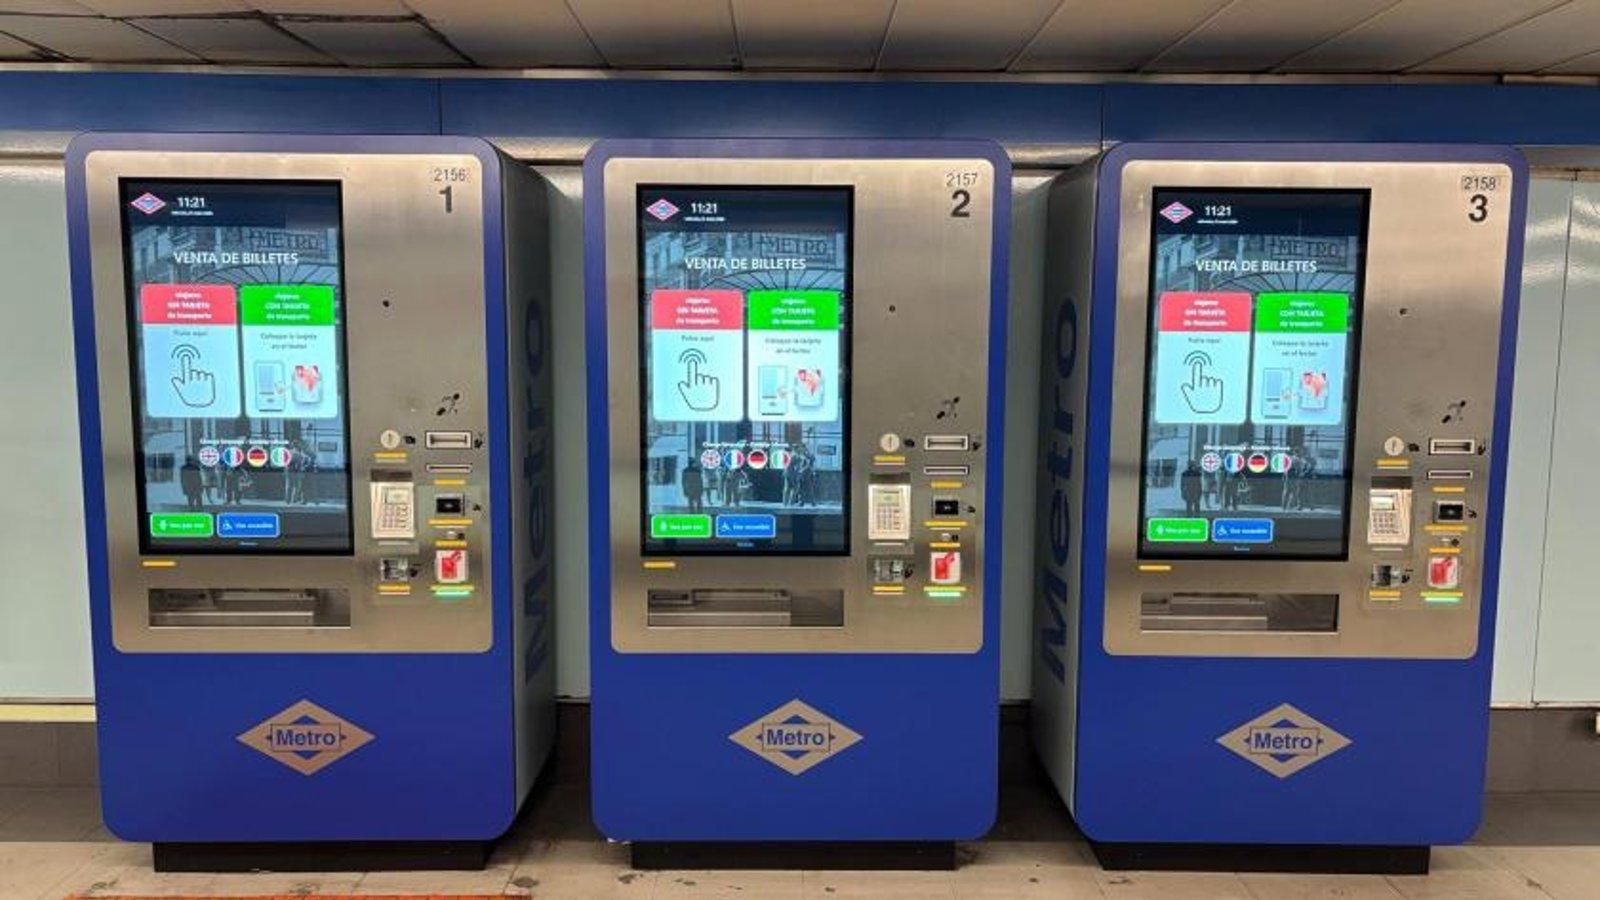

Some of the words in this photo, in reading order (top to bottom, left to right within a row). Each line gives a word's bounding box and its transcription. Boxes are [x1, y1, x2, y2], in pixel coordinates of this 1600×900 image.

[946, 172, 977, 187] 2157
[177, 196, 205, 208] 11:21
[439, 186, 452, 214] 1
[691, 203, 717, 214] 11:21
[951, 190, 970, 218] 2
[1468, 194, 1488, 223] 3
[1205, 205, 1231, 216] 11:21
[174, 252, 217, 264] VENTA
[222, 252, 240, 264] DE
[243, 252, 298, 265] BILLETES
[684, 258, 728, 270] VENTA
[731, 258, 749, 269] DE
[752, 258, 806, 269] BILLETES
[1195, 260, 1237, 272] VENTA
[1242, 260, 1259, 272] DE
[1262, 260, 1317, 273] BILLETES
[524, 298, 549, 686] Metro
[1040, 296, 1077, 686] Metro
[276, 728, 336, 746] Metro
[766, 729, 824, 746] Metro
[1254, 732, 1313, 749] Metro
